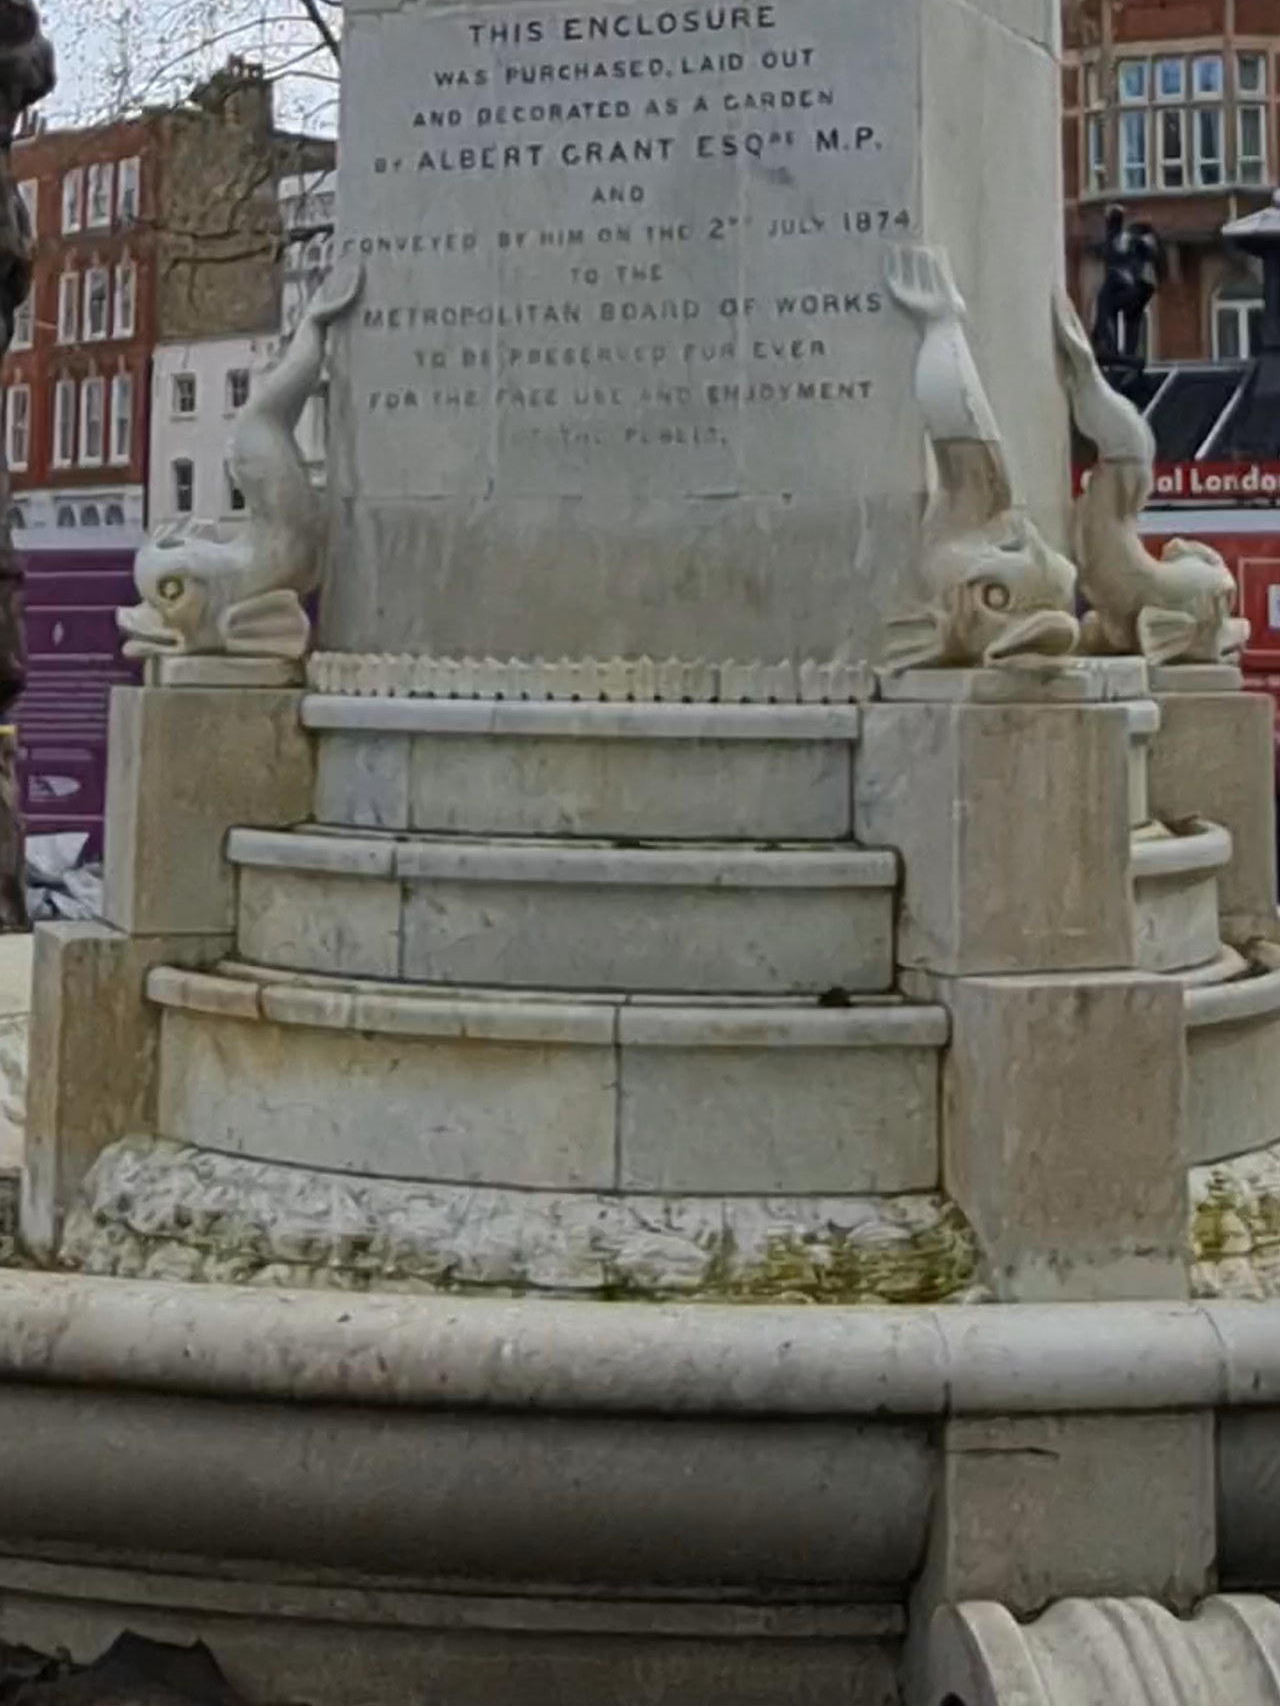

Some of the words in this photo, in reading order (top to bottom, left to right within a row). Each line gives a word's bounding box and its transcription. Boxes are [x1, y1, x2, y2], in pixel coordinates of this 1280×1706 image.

[468, 20, 544, 45] THIS
[563, 5, 776, 41] ENCLOSURE
[434, 69, 488, 87] WAS
[681, 52, 744, 76] LAID
[761, 48, 815, 70] OUT
[413, 109, 462, 128] AND
[477, 100, 631, 126] DECORATED
[645, 98, 678, 117] AS
[693, 94, 709, 113] A
[723, 89, 835, 113] GARDEN
[374, 157, 402, 174] BY
[417, 143, 544, 172] ALBERT
[560, 136, 675, 167] GRANT
[815, 125, 883, 153] M.P.
[590, 186, 645, 204] AND
[498, 230, 526, 249] BY
[540, 228, 584, 246] HIM
[597, 226, 630, 244] ON
[645, 224, 691, 243] THE
[767, 216, 825, 237] JULY
[843, 209, 910, 233] 1874
[571, 267, 598, 285] TO
[616, 263, 663, 282] THE
[363, 302, 580, 328] METROPOLITAN
[600, 298, 701, 321] BOARD
[719, 297, 756, 318] OF
[775, 292, 882, 317] WORKS
[753, 339, 826, 360] EVER
[369, 389, 418, 410] FOR
[433, 389, 477, 408] THE
[706, 380, 873, 406] ENJOYMENT
